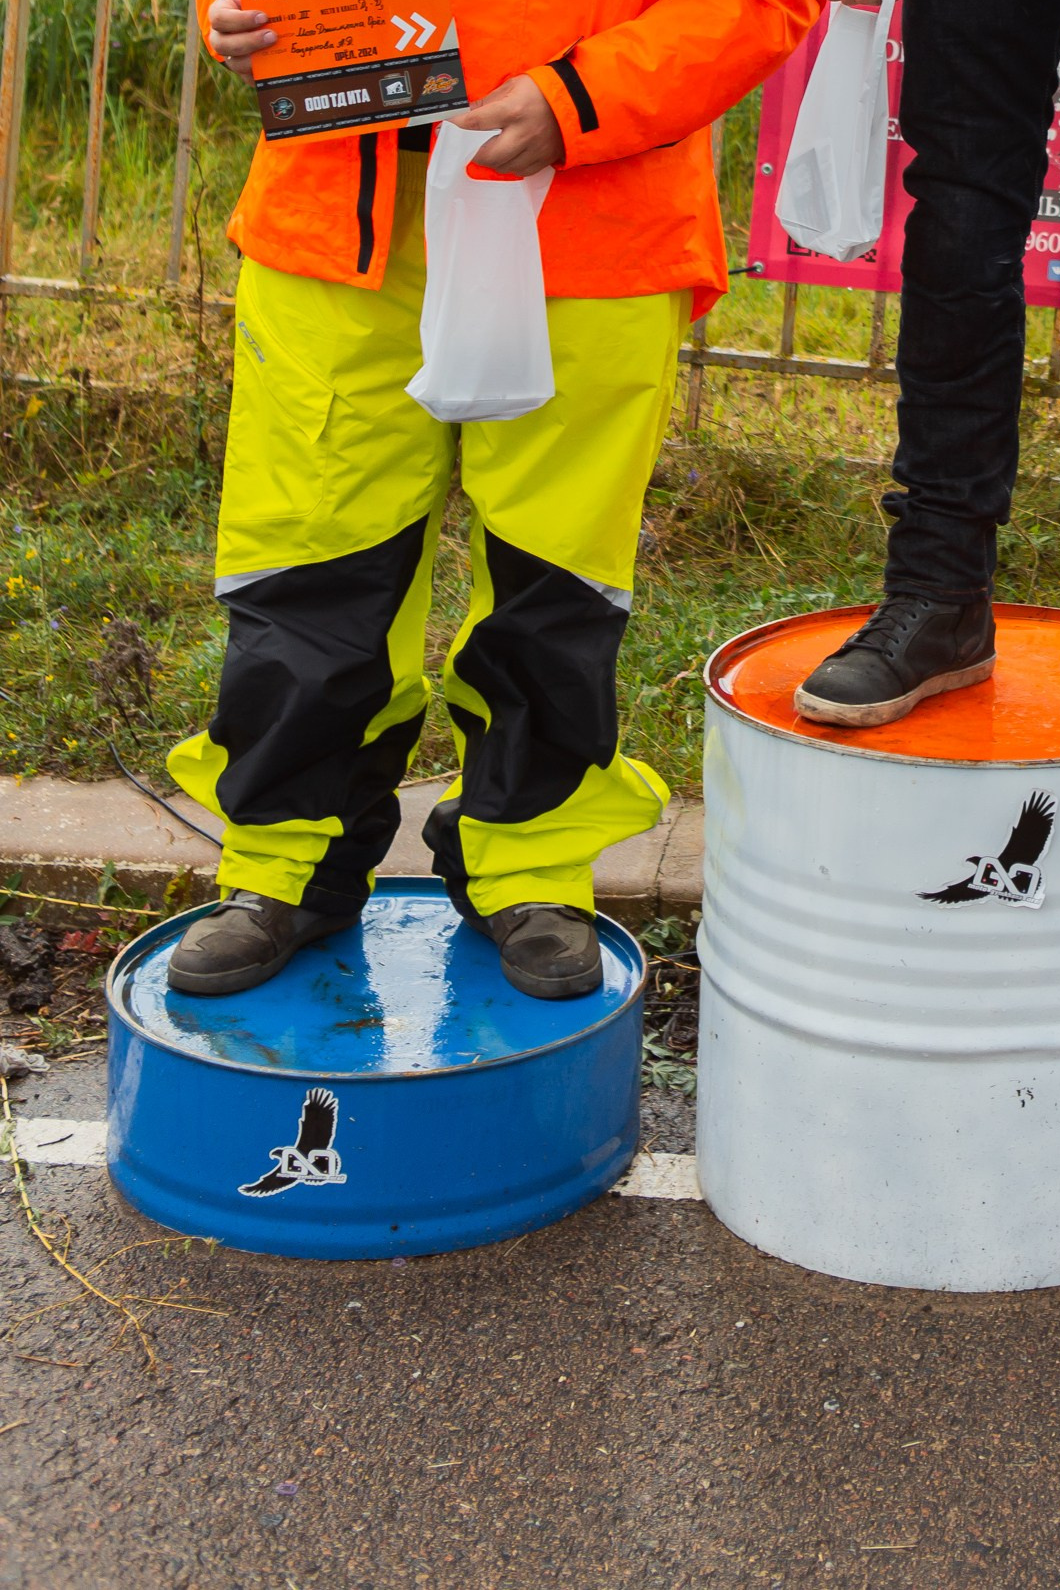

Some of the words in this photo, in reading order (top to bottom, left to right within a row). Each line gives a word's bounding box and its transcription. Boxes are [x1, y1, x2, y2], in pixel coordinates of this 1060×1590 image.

[358, 47, 378, 58] 2024
[305, 95, 330, 111] ООО
[329, 92, 347, 107] ТД
[347, 89, 370, 105] ИТА
